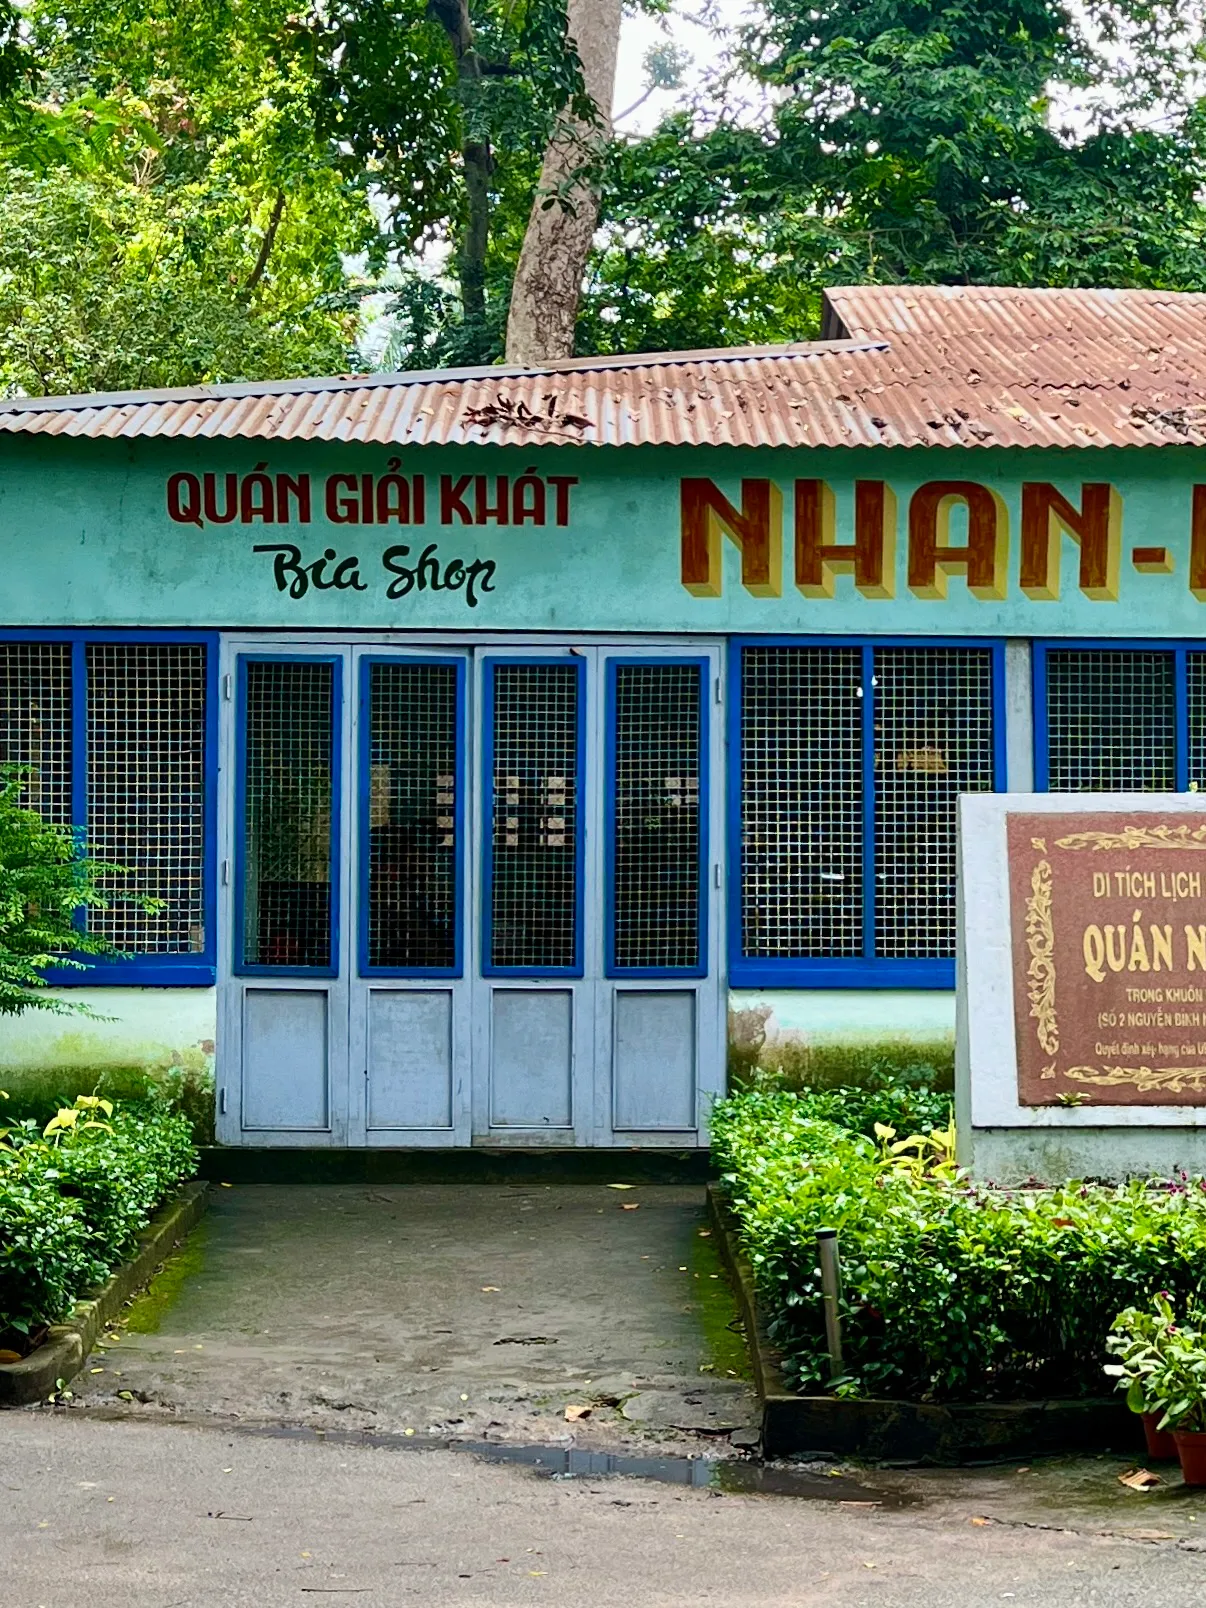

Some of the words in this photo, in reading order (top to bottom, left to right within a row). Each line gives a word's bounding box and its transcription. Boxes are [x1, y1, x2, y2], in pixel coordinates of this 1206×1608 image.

[166, 461, 311, 529] QUÁN
[324, 456, 426, 525] GIẢI
[440, 466, 580, 527] KHÁT
[253, 542, 368, 600] Bia
[381, 542, 497, 608] Shop
[1093, 871, 1111, 898] DI
[1114, 864, 1156, 898] TÍCH
[1160, 871, 1201, 902] LỊCH
[1083, 908, 1173, 983] QUÁN
[1119, 1012, 1125, 1027] 2
[1126, 988, 1163, 1002] TRONG
